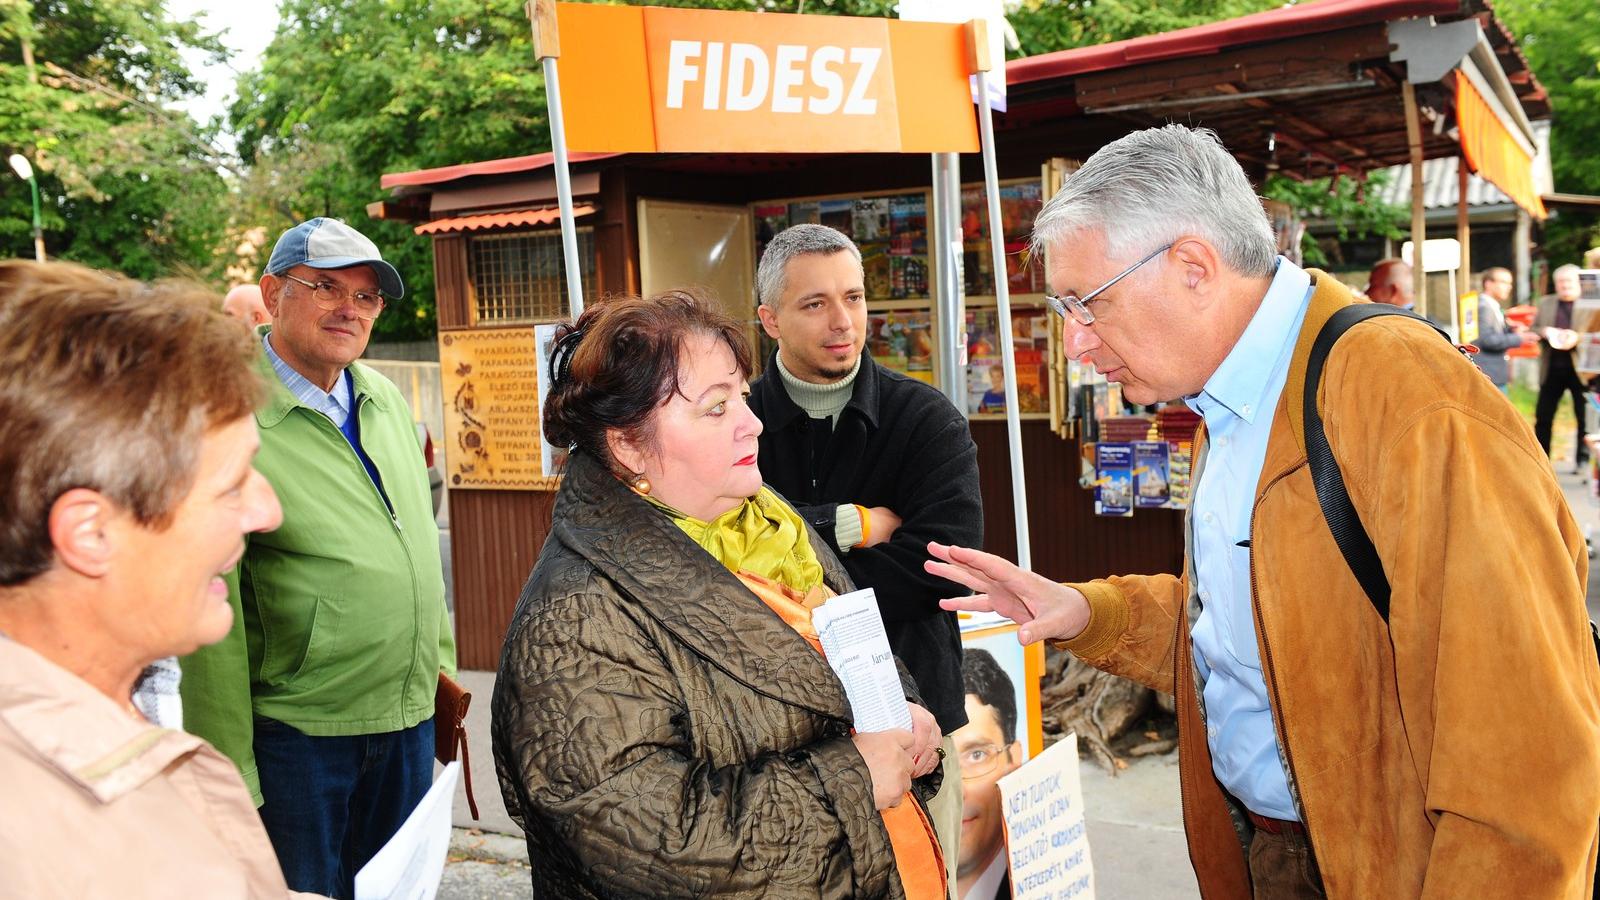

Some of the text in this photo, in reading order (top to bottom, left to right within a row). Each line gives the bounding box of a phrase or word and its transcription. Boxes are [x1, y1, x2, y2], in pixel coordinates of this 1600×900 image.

[666, 40, 882, 115] FIDESZ
[488, 416, 524, 425] TIFFANY
[493, 429, 528, 438] TIFFANY
[495, 441, 531, 450] TIFFANY
